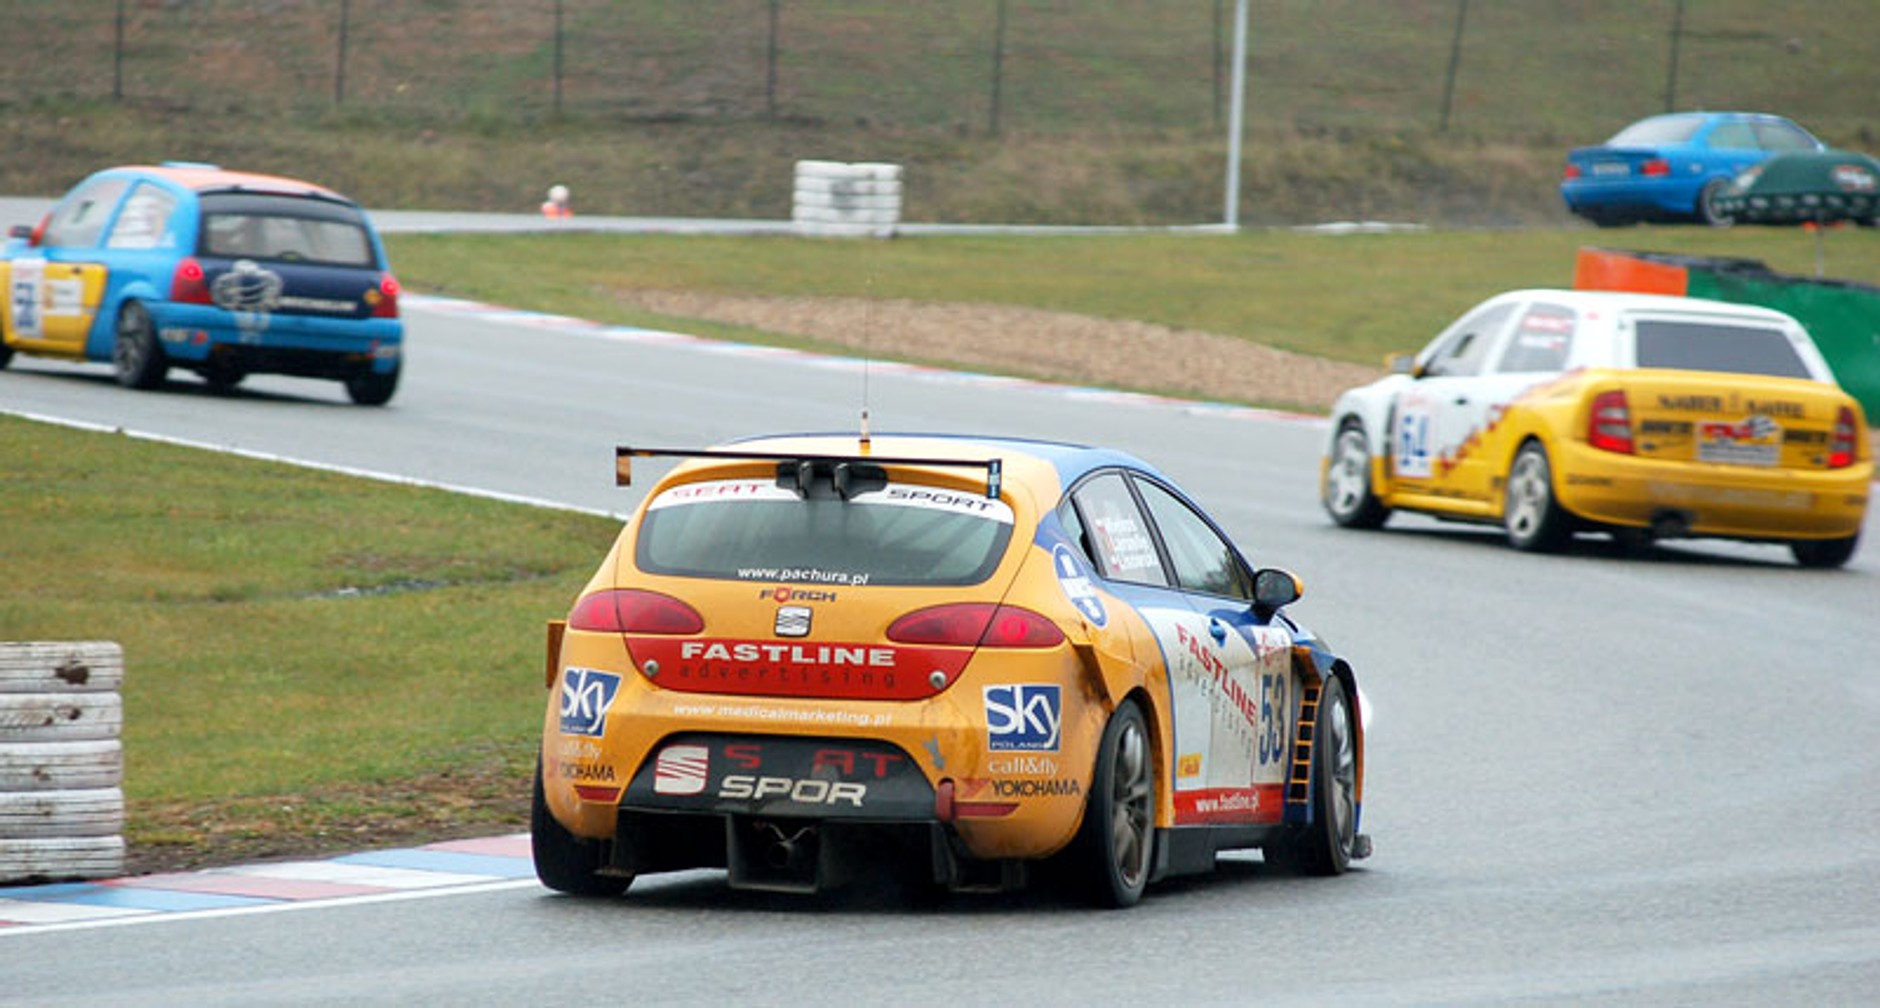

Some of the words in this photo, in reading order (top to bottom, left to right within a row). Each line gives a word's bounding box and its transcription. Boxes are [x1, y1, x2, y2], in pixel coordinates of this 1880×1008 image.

[886, 488, 994, 512] SPORT
[737, 566, 870, 587] www.pachura.pl
[680, 641, 897, 668] FASTLINE
[679, 663, 897, 688] advertising
[1175, 622, 1257, 728] FASTLINE
[1259, 673, 1286, 767] 53
[991, 778, 1081, 796] YOKOHAMA
